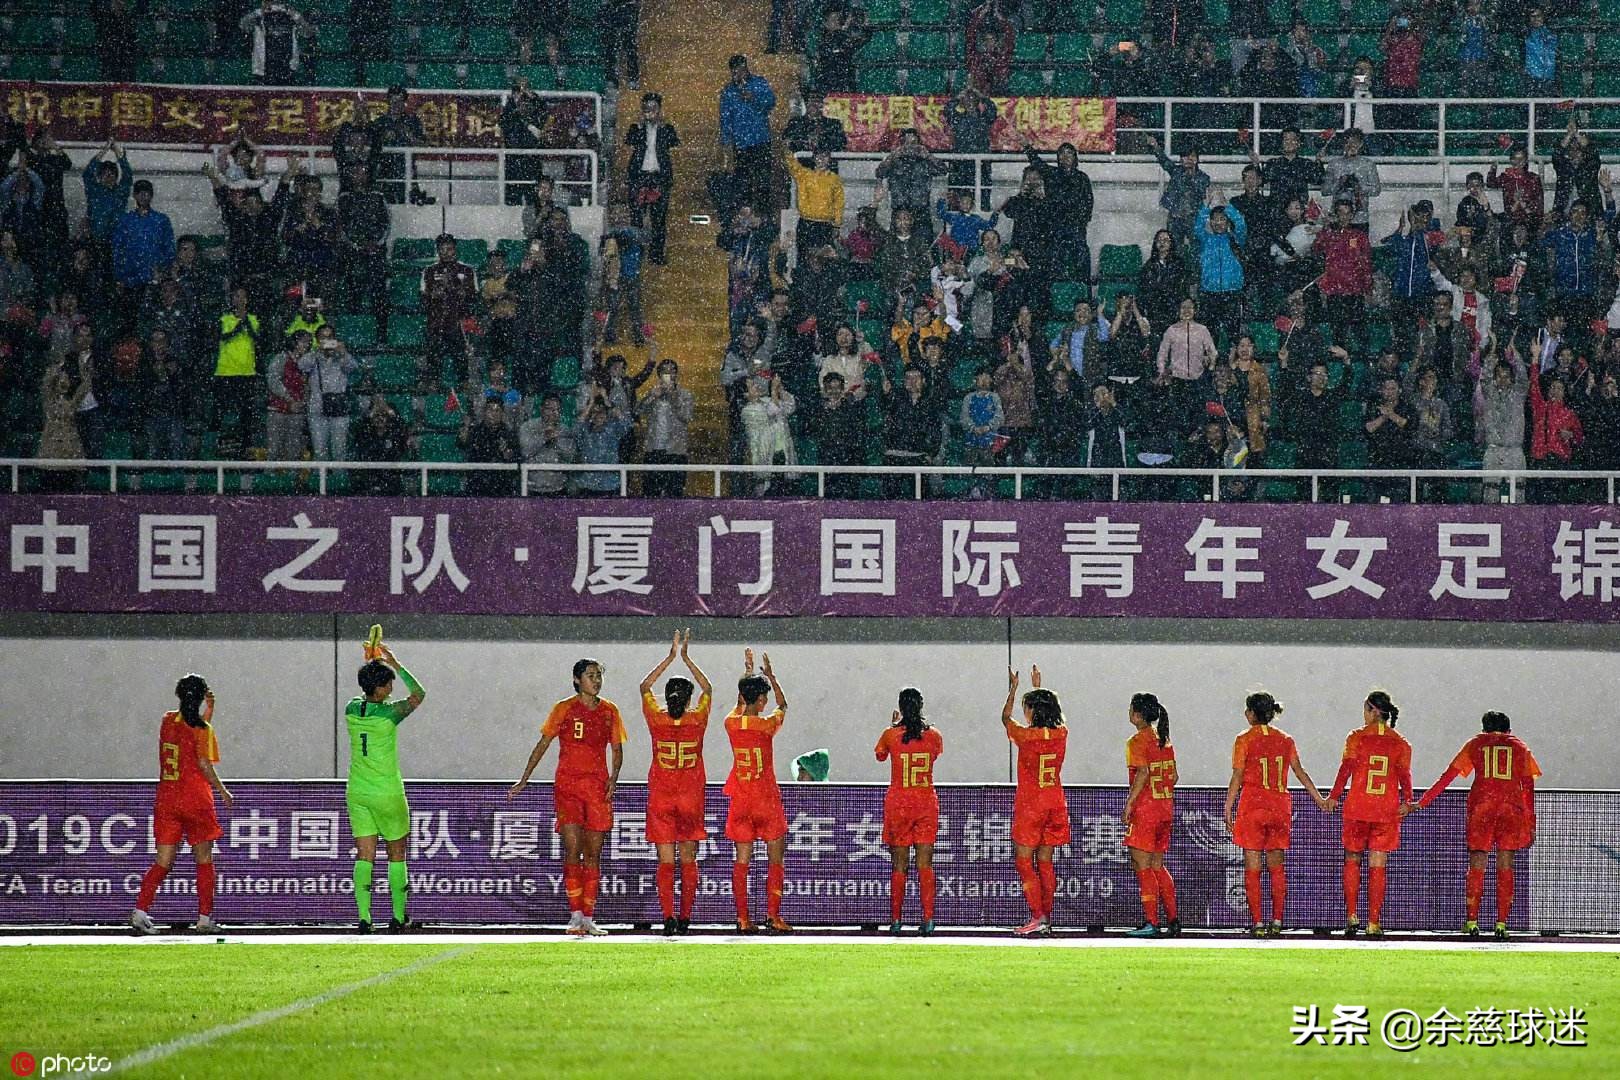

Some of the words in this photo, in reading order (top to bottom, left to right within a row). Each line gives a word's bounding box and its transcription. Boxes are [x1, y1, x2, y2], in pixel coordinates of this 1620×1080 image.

[359, 733, 368, 757] 1
[573, 720, 584, 739] 9
[162, 742, 180, 781] 3
[733, 746, 763, 781] 21
[900, 752, 930, 788] 12
[1039, 753, 1057, 788] 6
[1150, 759, 1174, 799] 23
[1259, 755, 1285, 794] 11
[1366, 755, 1389, 794] 2
[1482, 745, 1513, 781] 10
[37, 874, 112, 894] Team
[409, 873, 536, 895] Women's
[548, 874, 627, 895] Yth
[936, 875, 1019, 897] Xiame
[1053, 876, 1114, 898] 2019
